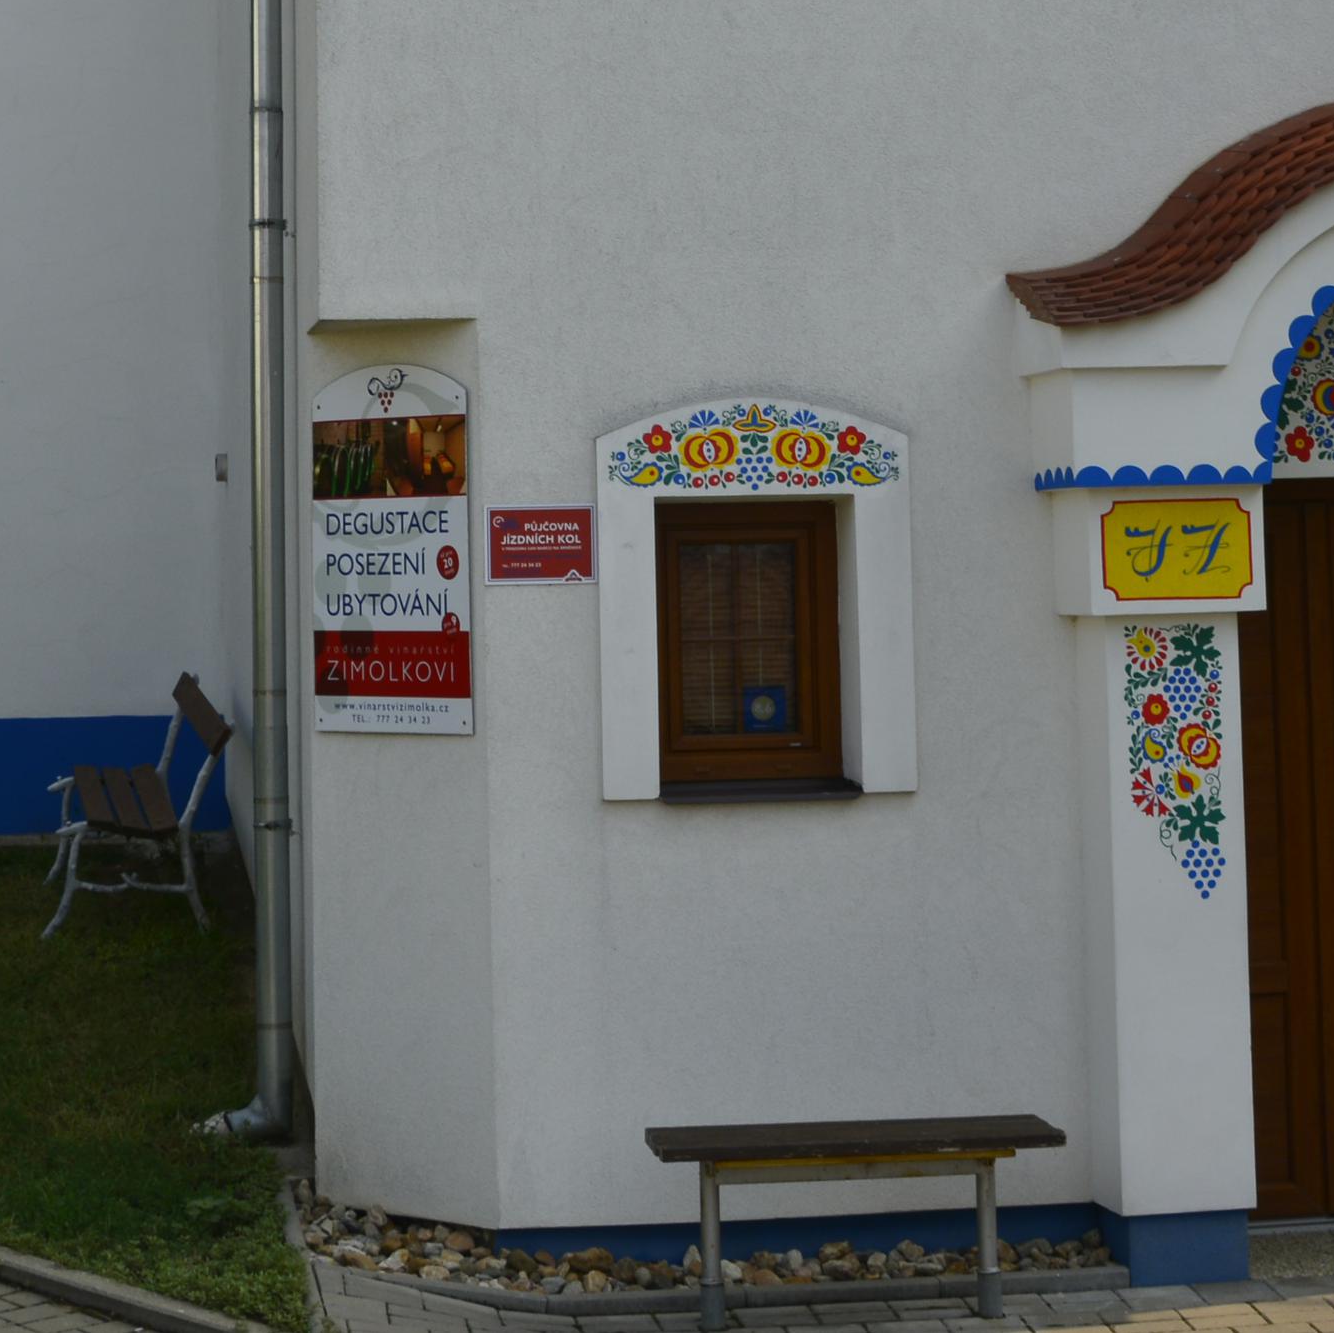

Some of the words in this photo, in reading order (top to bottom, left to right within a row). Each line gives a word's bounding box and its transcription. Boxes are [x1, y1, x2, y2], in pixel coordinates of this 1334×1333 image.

[326, 510, 449, 535] DEGUSTACE
[524, 520, 579, 532] PŮJČOVNA
[501, 532, 554, 545] JÍZDNÍCH
[557, 534, 581, 544] KOL
[326, 547, 426, 576] POSEZENÍ
[443, 557, 453, 569] 20
[326, 588, 448, 617] UBYTOVÁNÍ
[327, 644, 380, 655] rodinné
[327, 660, 455, 682] ZIMOLKOVI
[334, 701, 450, 713] www.vinarstvizimolka.cz
[377, 715, 390, 724] 777
[395, 715, 404, 724] 24
[408, 715, 417, 724] 34
[422, 716, 431, 725] 23
